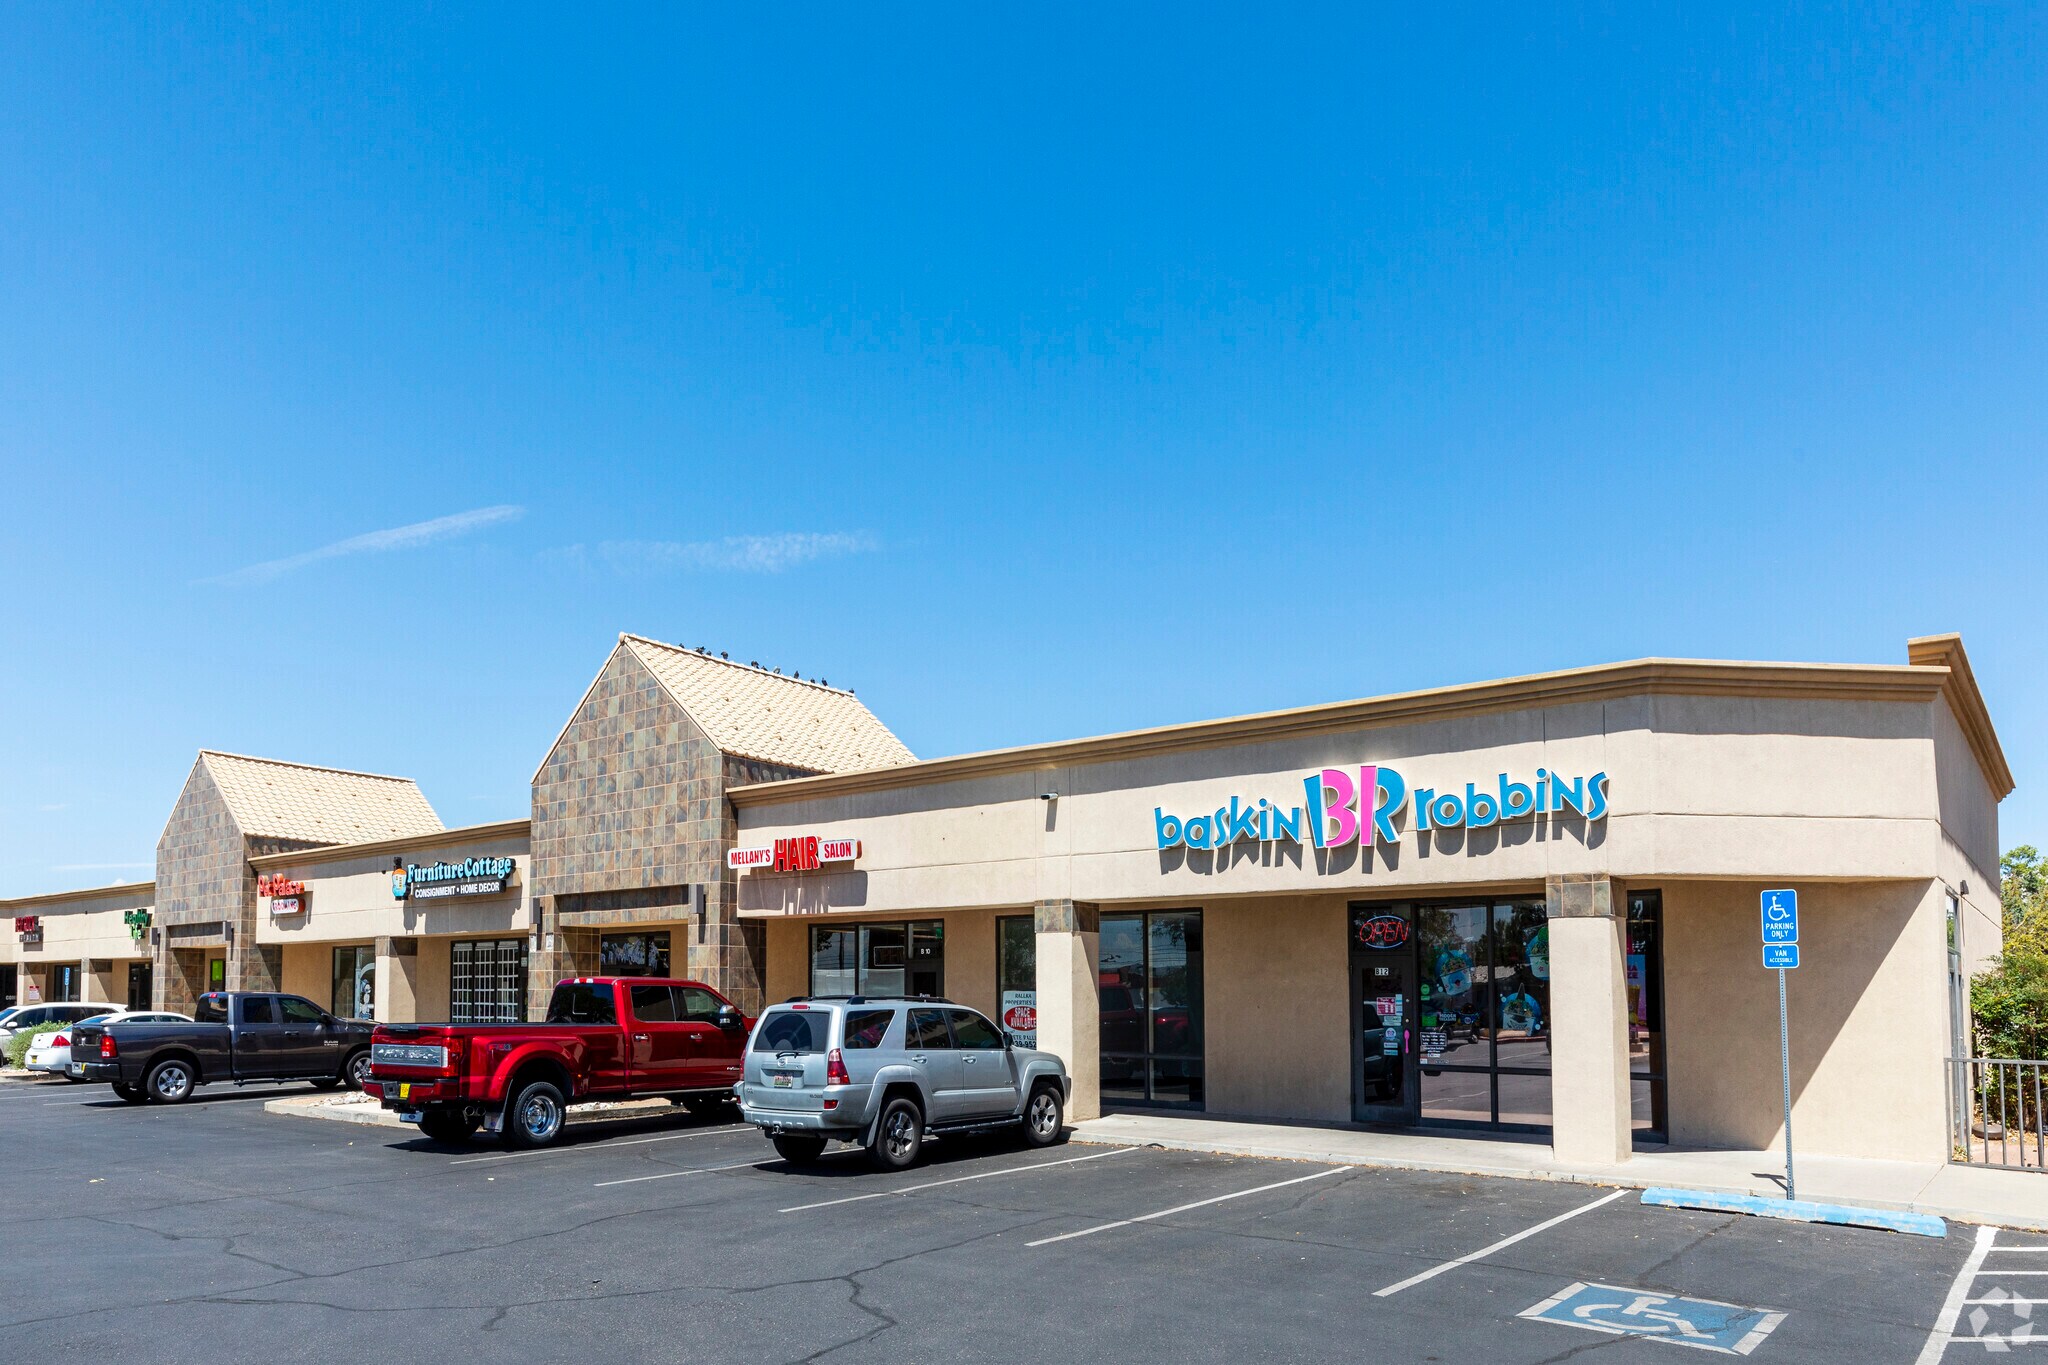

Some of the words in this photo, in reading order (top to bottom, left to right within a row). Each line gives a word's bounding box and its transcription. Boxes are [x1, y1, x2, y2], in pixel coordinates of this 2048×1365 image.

[1154, 795, 1302, 850] baskin
[1414, 768, 1609, 831] robbins
[731, 849, 771, 865] MELLANY'S
[774, 835, 819, 872] HAIR
[824, 842, 851, 859] SALON
[414, 886, 456, 898] CONSIGNMENT
[460, 884, 478, 894] HOME
[478, 882, 500, 893] DECOR
[1359, 921, 1409, 942] OPEN
[1765, 922, 1794, 930] PARKING
[1771, 930, 1789, 938] ONLY
[1014, 1007, 1030, 1018] SPACE
[1010, 1017, 1037, 1028] AVAILABLE
